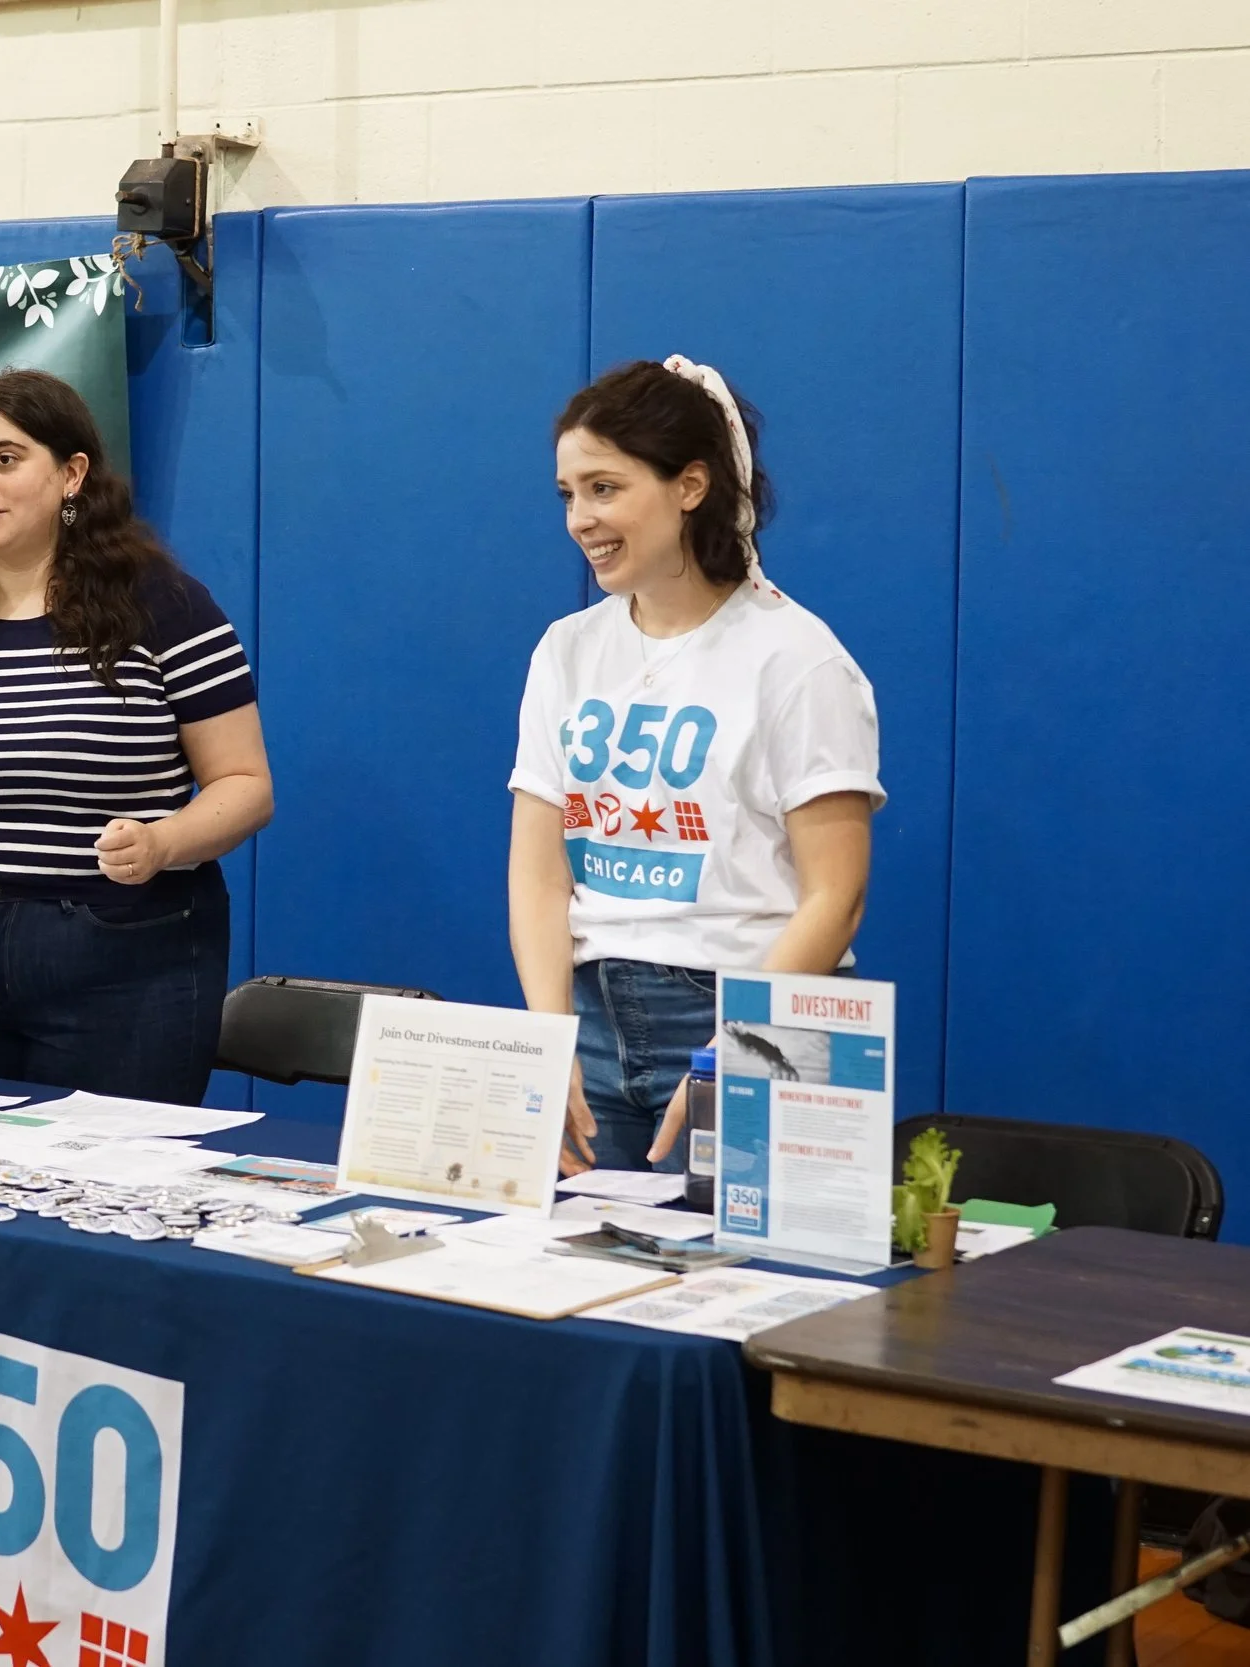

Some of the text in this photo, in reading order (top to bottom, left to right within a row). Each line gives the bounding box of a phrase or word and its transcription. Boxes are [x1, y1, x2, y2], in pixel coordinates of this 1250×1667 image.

[569, 698, 717, 789] 350
[584, 853, 684, 887] CHICAGO
[791, 993, 872, 1022] DIVESTMENT
[378, 1026, 543, 1056] Join Our Divestment Coalition
[731, 1188, 759, 1206] 350
